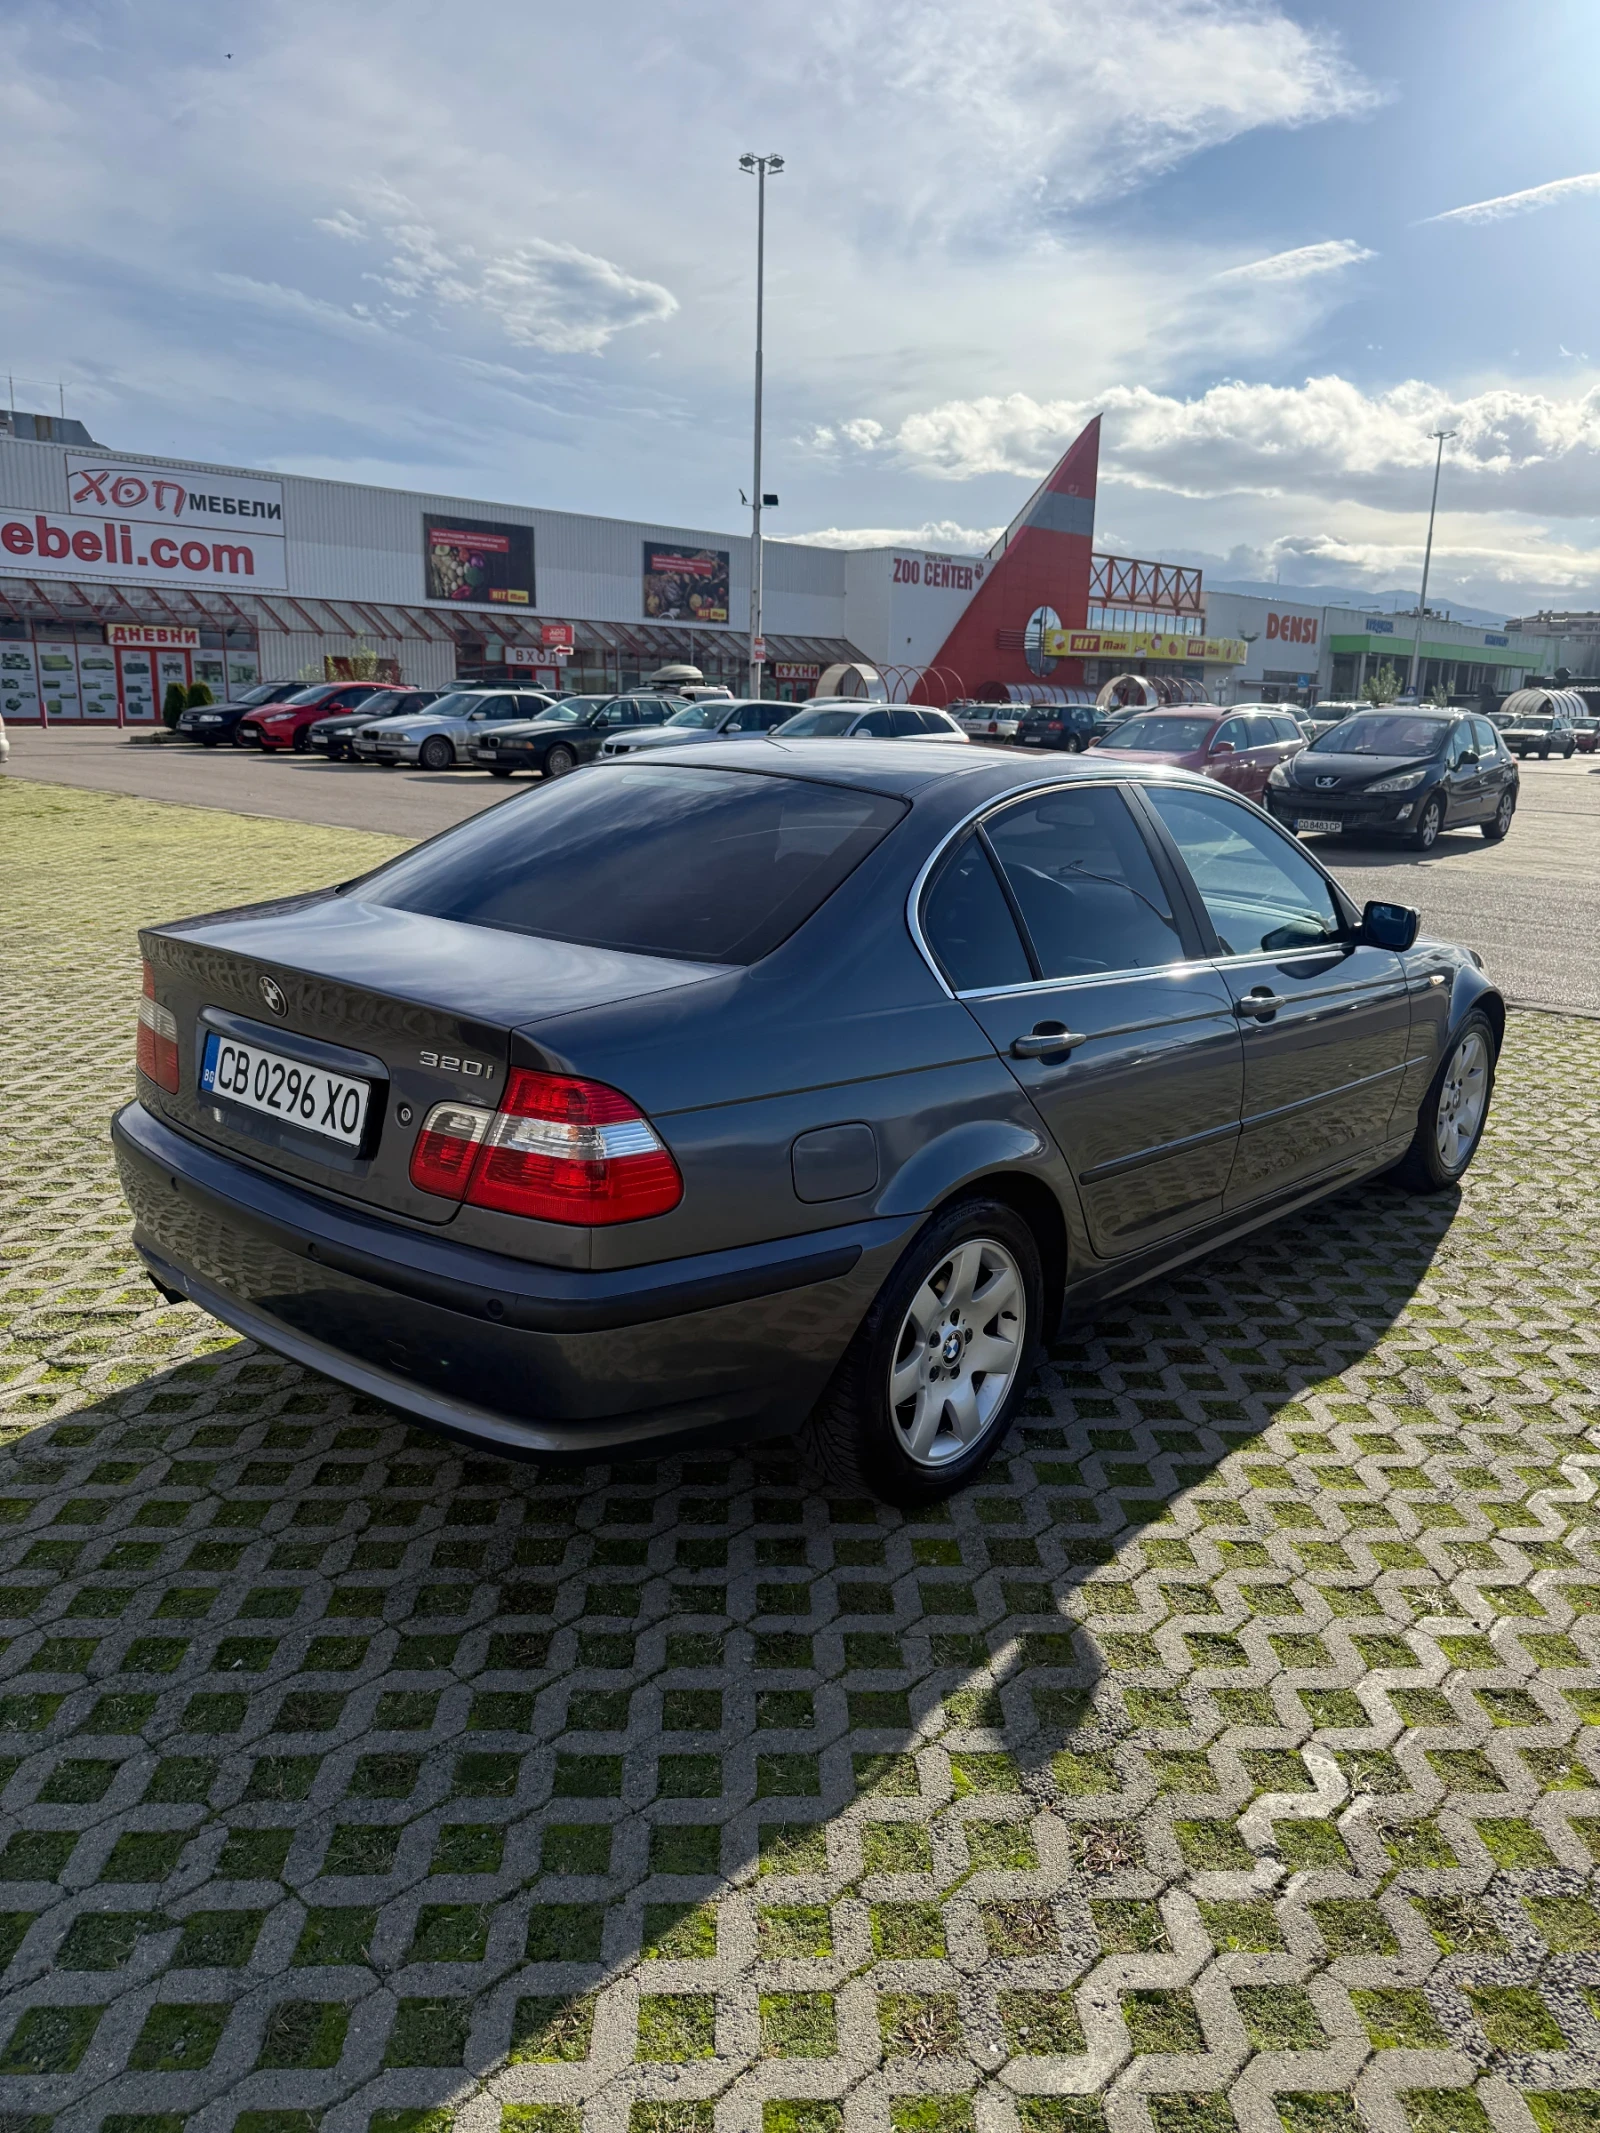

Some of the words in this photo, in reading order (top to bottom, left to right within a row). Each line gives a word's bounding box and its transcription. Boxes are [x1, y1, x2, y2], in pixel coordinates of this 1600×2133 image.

[73, 471, 188, 518] ХОП
[189, 493, 282, 520] МЕБЕЛИ
[893, 558, 920, 585] ZOO
[924, 562, 973, 590] CENTER
[491, 590, 507, 600] HIT
[113, 626, 197, 644] ДНЕВНИ
[1266, 612, 1318, 644] DENSI
[1073, 637, 1097, 650] HIT
[1102, 639, 1126, 651] Max
[1188, 642, 1205, 654] HIT
[516, 649, 557, 665] ВХОД
[777, 664, 818, 678] КУХНИ
[1298, 819, 1309, 829] CO
[1309, 820, 1329, 830] 8483
[1329, 822, 1341, 831] CP
[419, 1050, 494, 1079] 320i
[204, 1069, 215, 1083] BG
[218, 1046, 250, 1095] CB
[254, 1058, 316, 1119] 0296
[320, 1079, 360, 1134] XO
